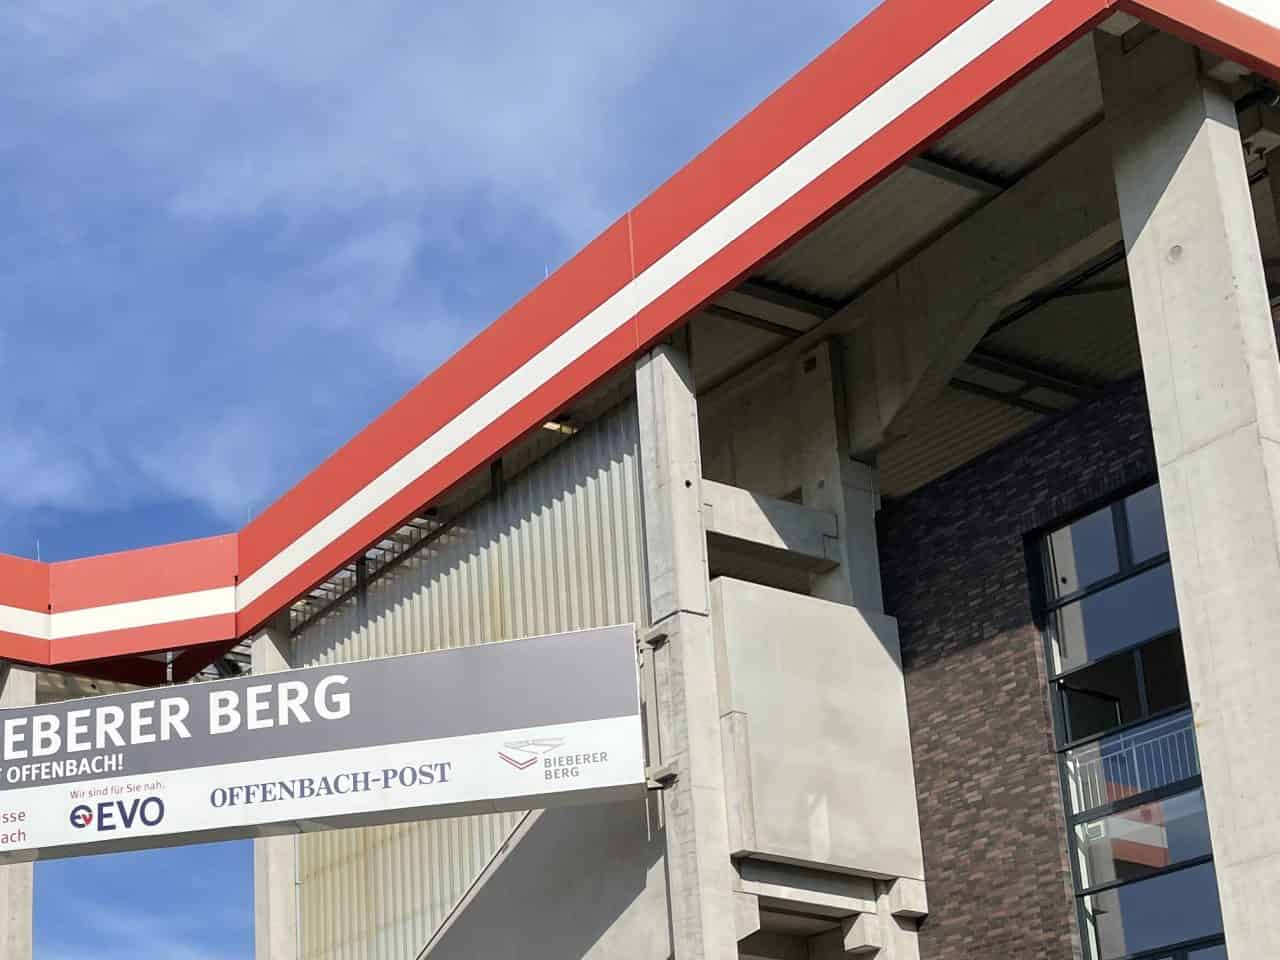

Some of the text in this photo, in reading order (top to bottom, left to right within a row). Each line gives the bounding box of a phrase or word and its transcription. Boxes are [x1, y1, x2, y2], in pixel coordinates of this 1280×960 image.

[208, 674, 352, 735] BERG
[6, 753, 124, 784] OFFENBACH!
[544, 751, 609, 768] BIEBERER
[209, 761, 453, 809] OFFENBACH-POST
[544, 766, 581, 781] BERG
[70, 790, 85, 799] Wir
[88, 786, 108, 798] sind
[110, 785, 124, 795] für
[126, 783, 142, 793] Sie
